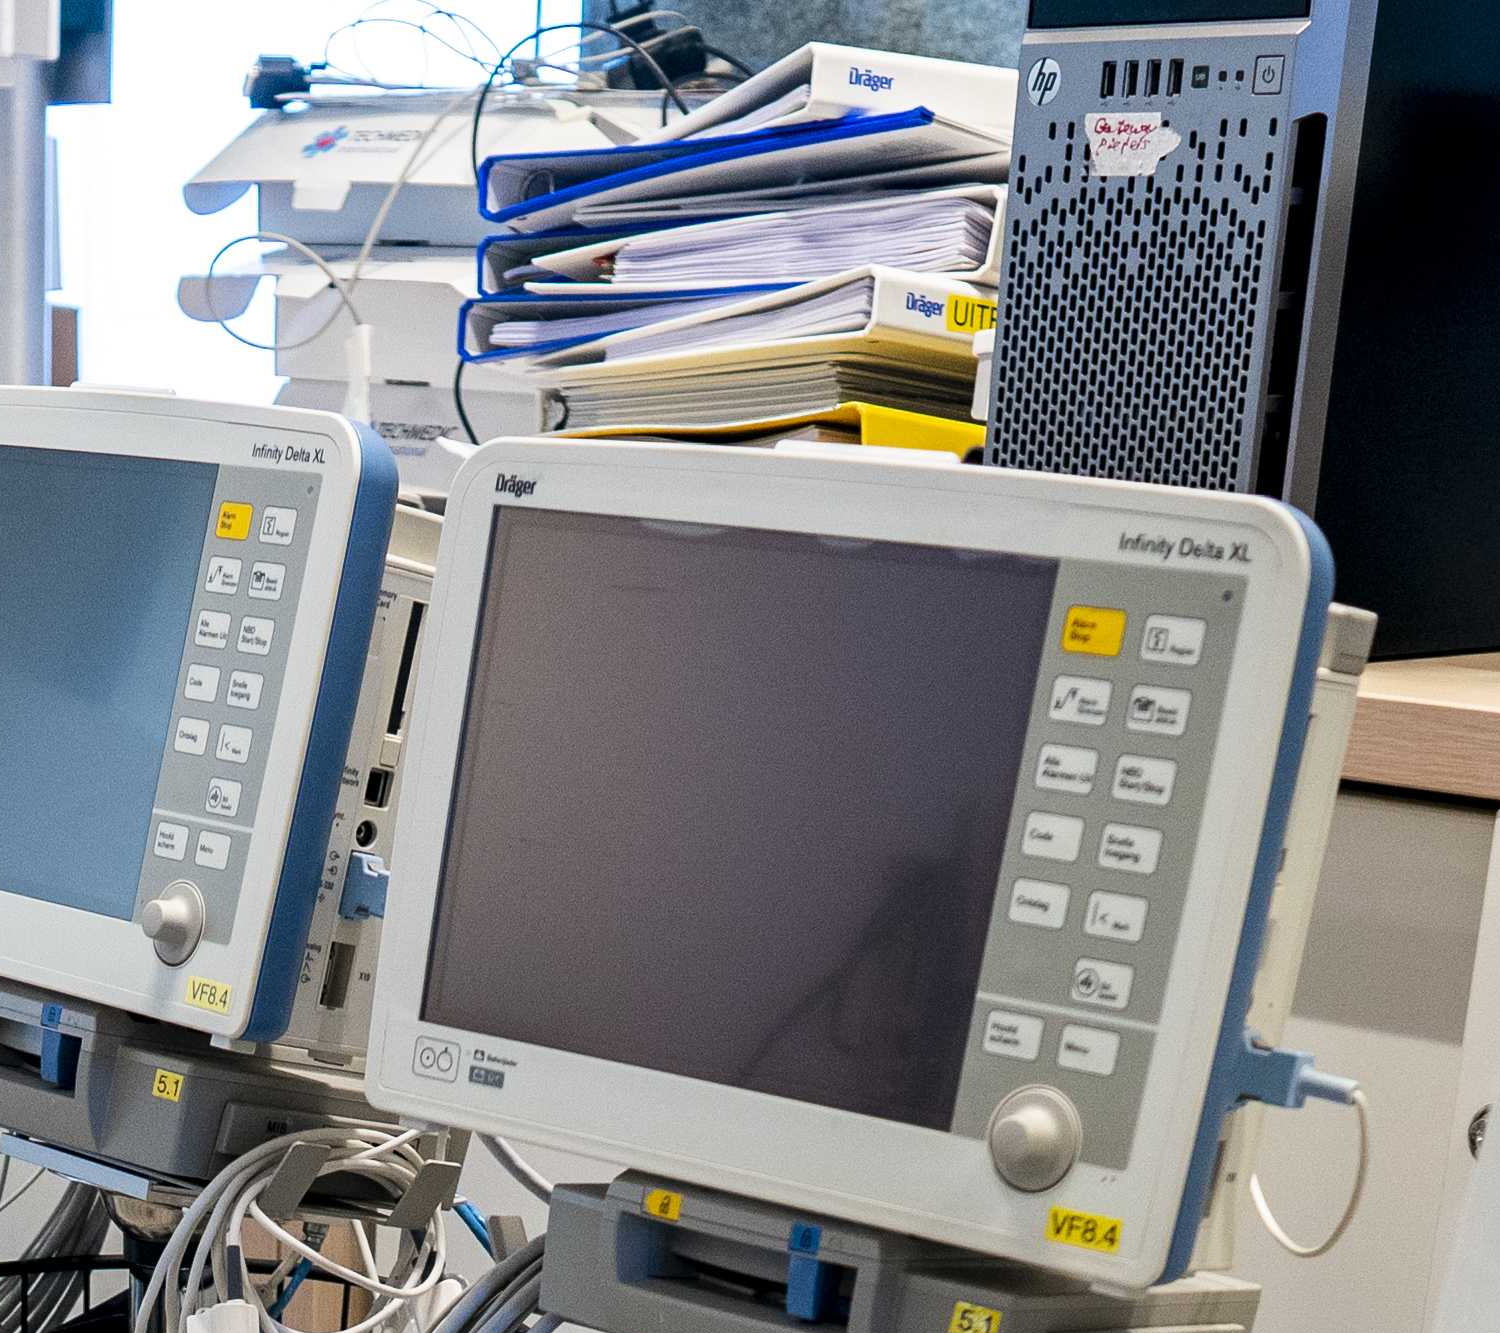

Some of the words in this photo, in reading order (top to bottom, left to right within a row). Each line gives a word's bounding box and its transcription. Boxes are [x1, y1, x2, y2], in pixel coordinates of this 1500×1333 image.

[849, 67, 894, 92] Dräger
[1032, 57, 1056, 106] hp
[906, 292, 945, 318] Dräger
[251, 443, 283, 465] Infinity
[285, 445, 311, 463] Delta
[312, 447, 326, 464] XL
[495, 472, 537, 498] Dräger
[1118, 531, 1176, 560] Infinity
[1178, 537, 1226, 560] Delta
[1228, 541, 1252, 563] XL
[190, 982, 229, 1010] VF8.4
[156, 1072, 181, 1097] 5.1
[1050, 1212, 1120, 1248] VF8.4
